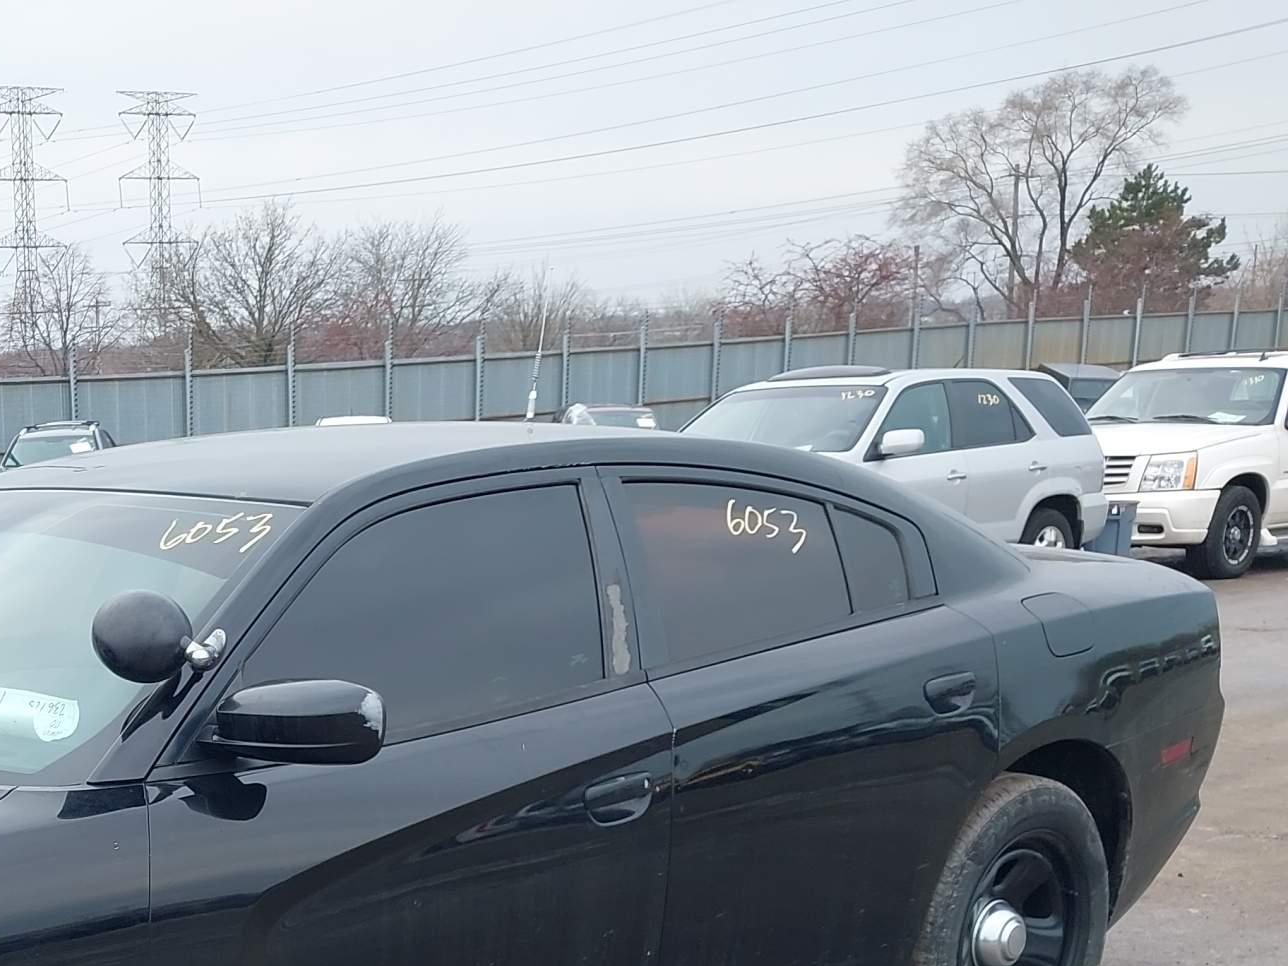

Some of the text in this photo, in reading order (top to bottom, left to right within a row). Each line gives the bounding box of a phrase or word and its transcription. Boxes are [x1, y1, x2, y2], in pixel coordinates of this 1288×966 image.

[977, 394, 1001, 407] 1230
[159, 511, 274, 553] 6053
[726, 498, 808, 554] 6053
